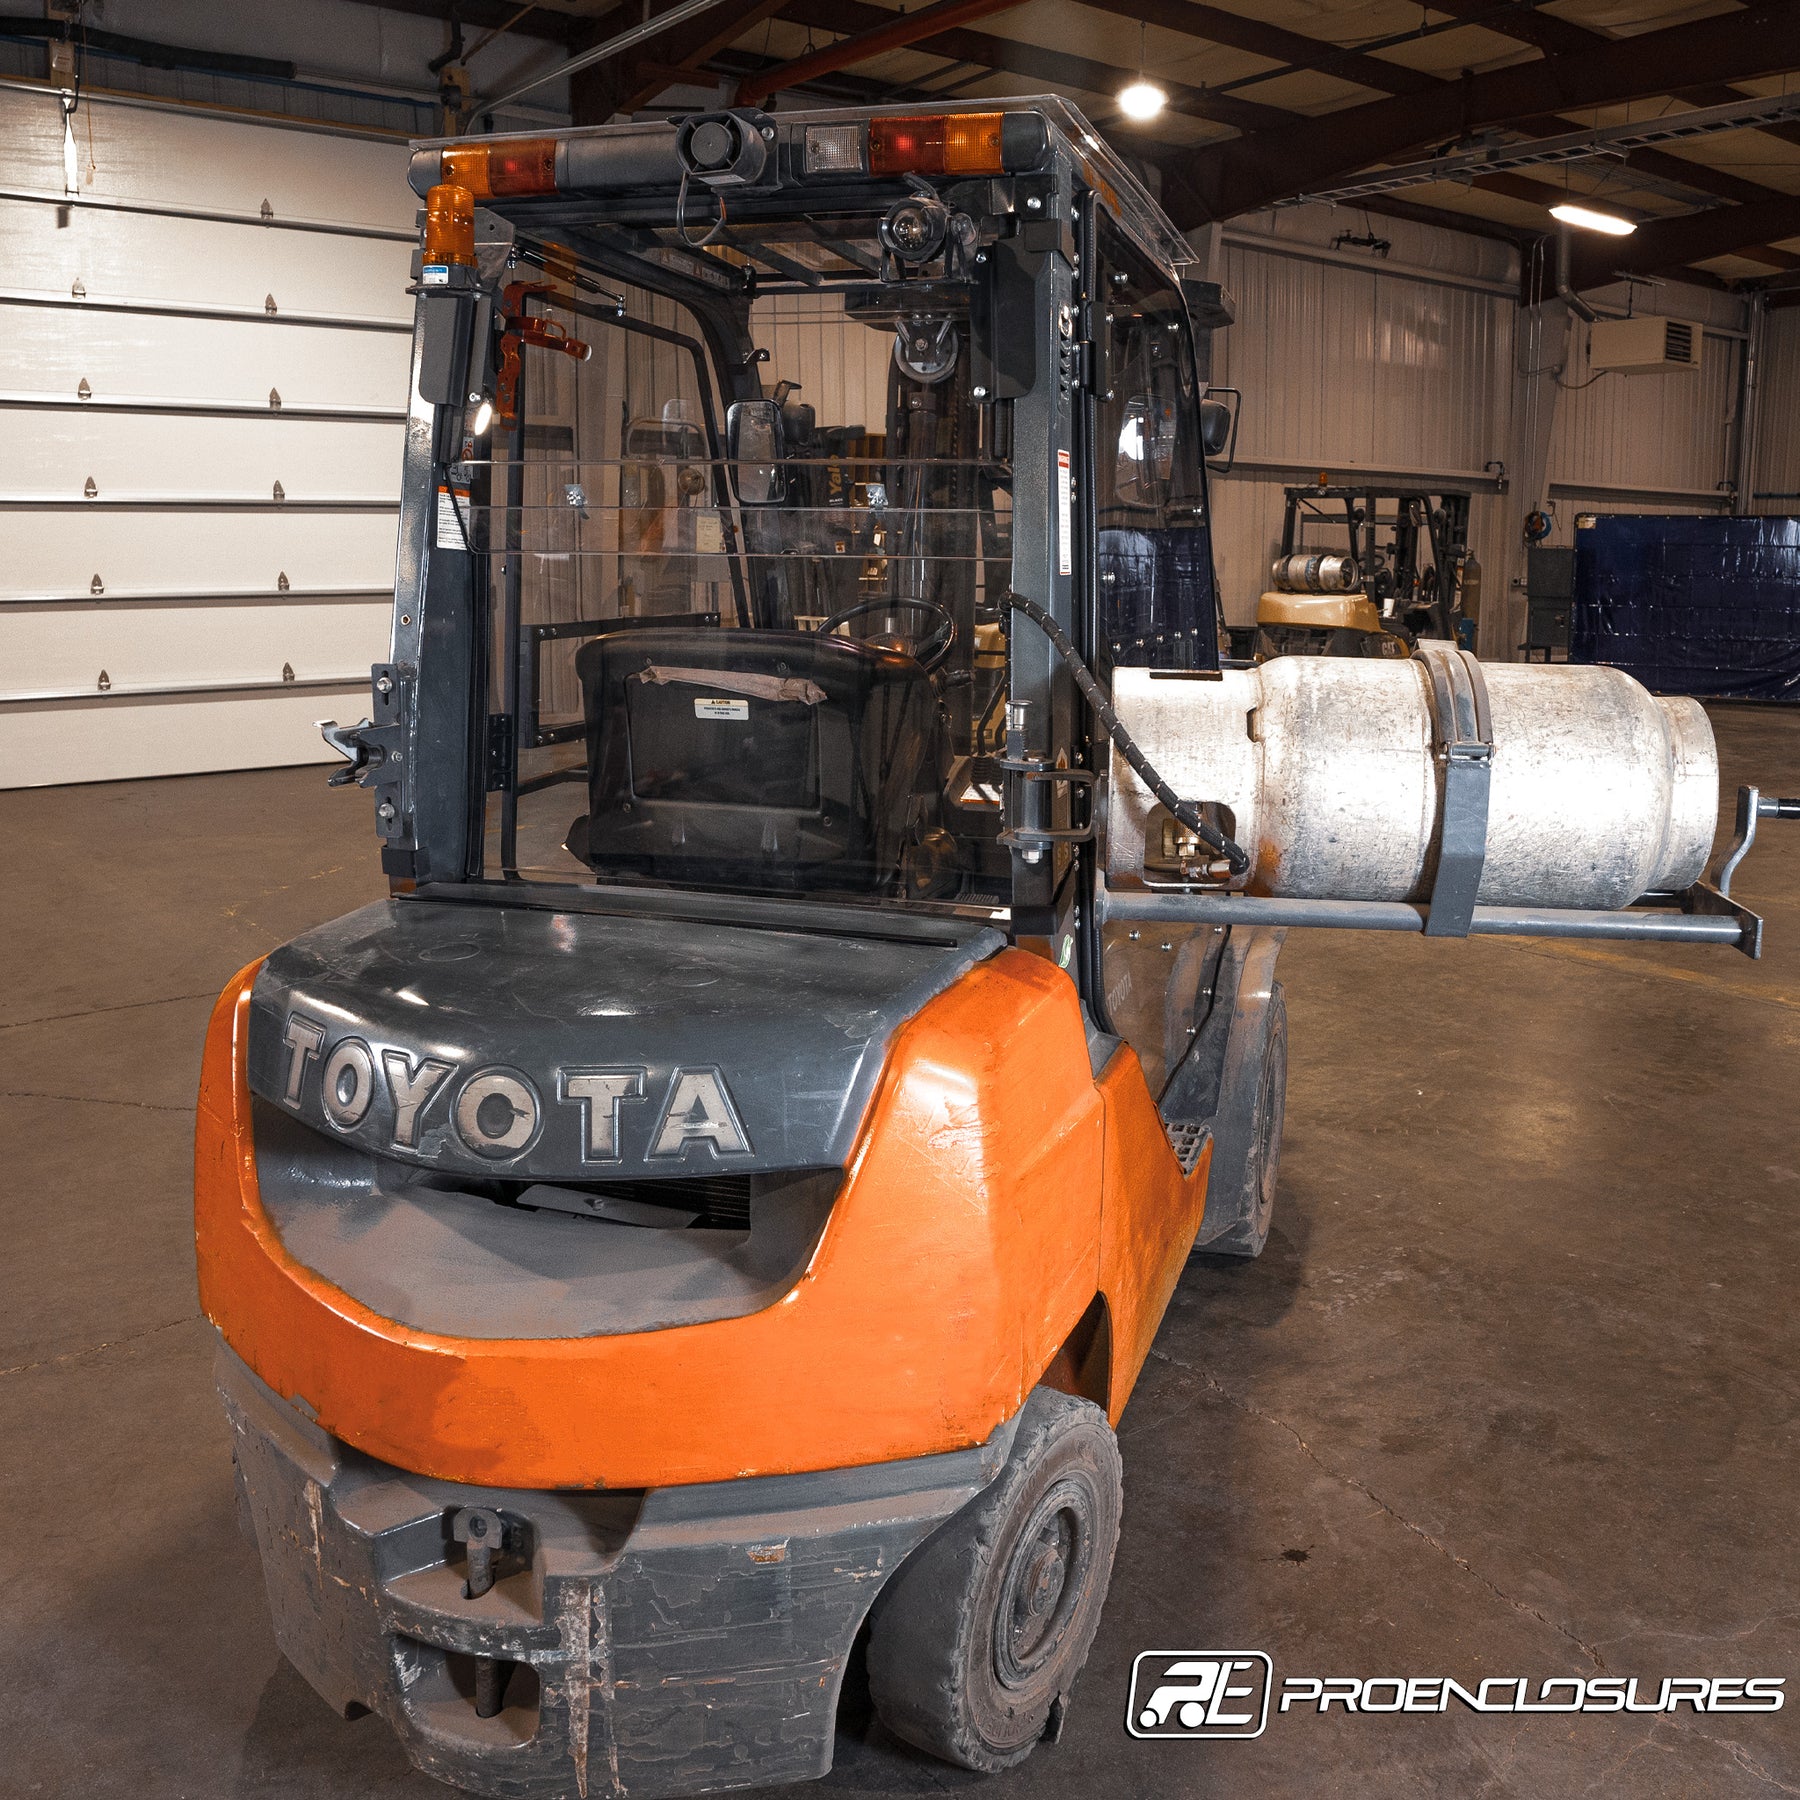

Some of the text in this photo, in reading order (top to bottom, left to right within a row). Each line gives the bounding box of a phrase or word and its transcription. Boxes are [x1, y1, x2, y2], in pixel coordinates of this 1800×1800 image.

[1382, 641, 1395, 656] CAT
[1107, 970, 1132, 1016] TOYOTA
[284, 1012, 755, 1165] TOYOTA
